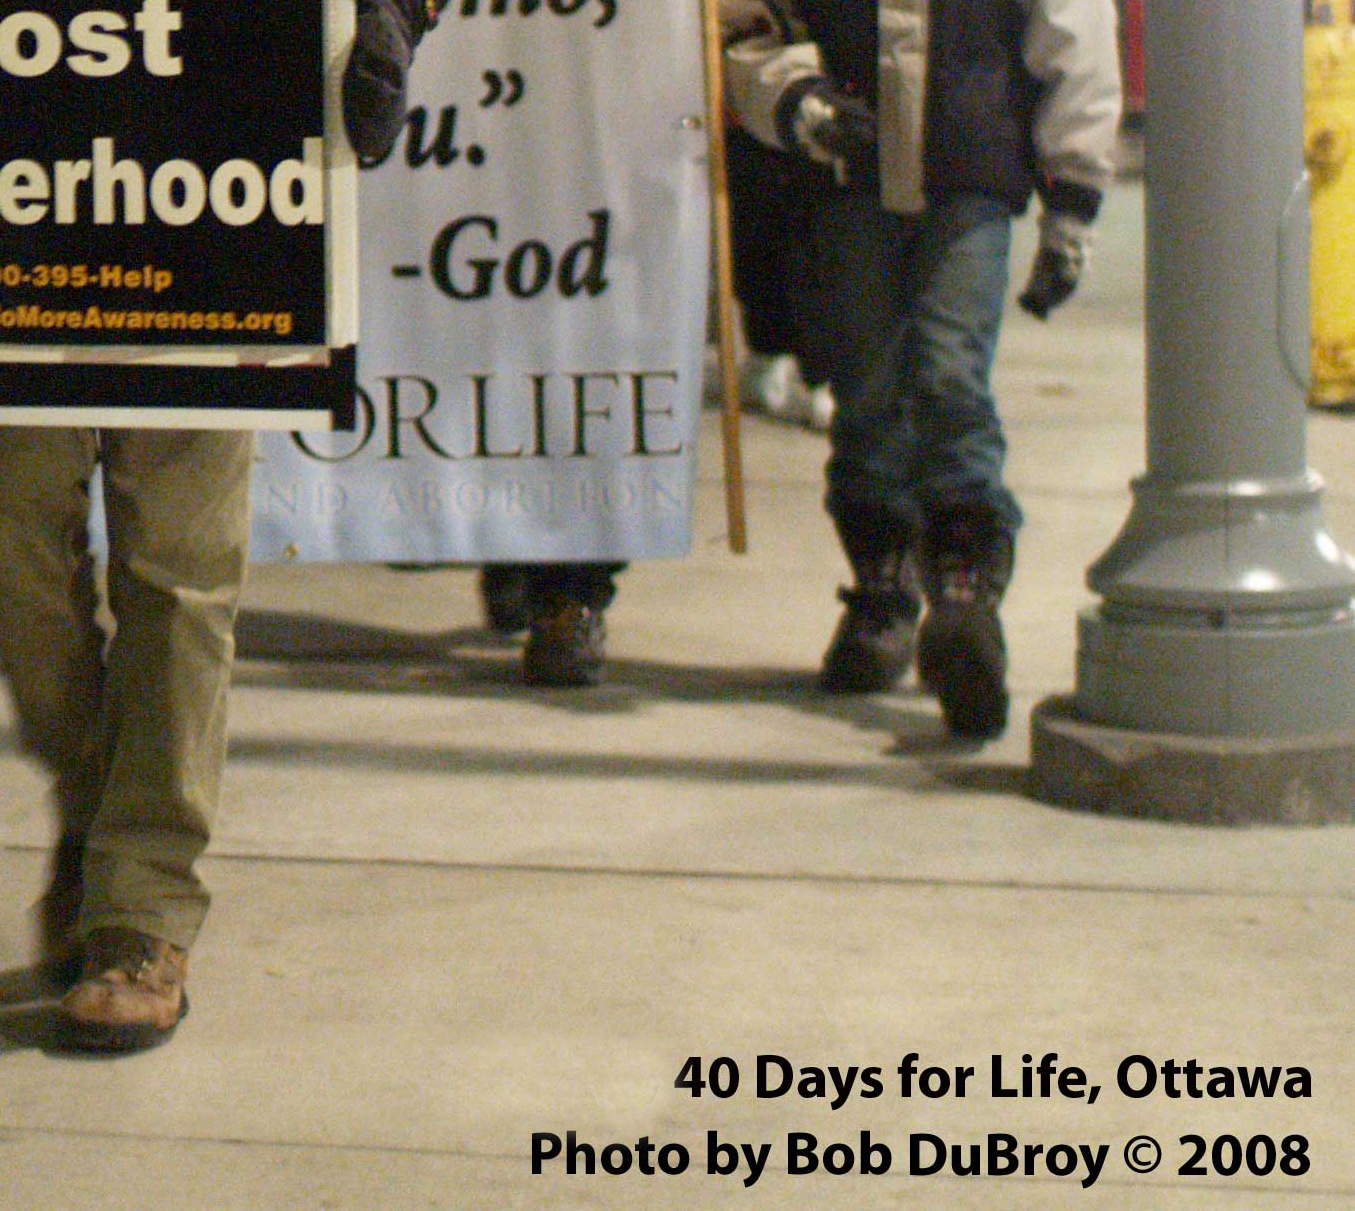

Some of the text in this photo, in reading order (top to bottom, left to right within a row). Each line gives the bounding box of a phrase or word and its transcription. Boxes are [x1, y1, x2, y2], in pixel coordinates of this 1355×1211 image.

[359, 67, 524, 170] u.”
[391, 209, 612, 302] -God
[289, 374, 460, 463] OR
[468, 371, 683, 458] LIFE
